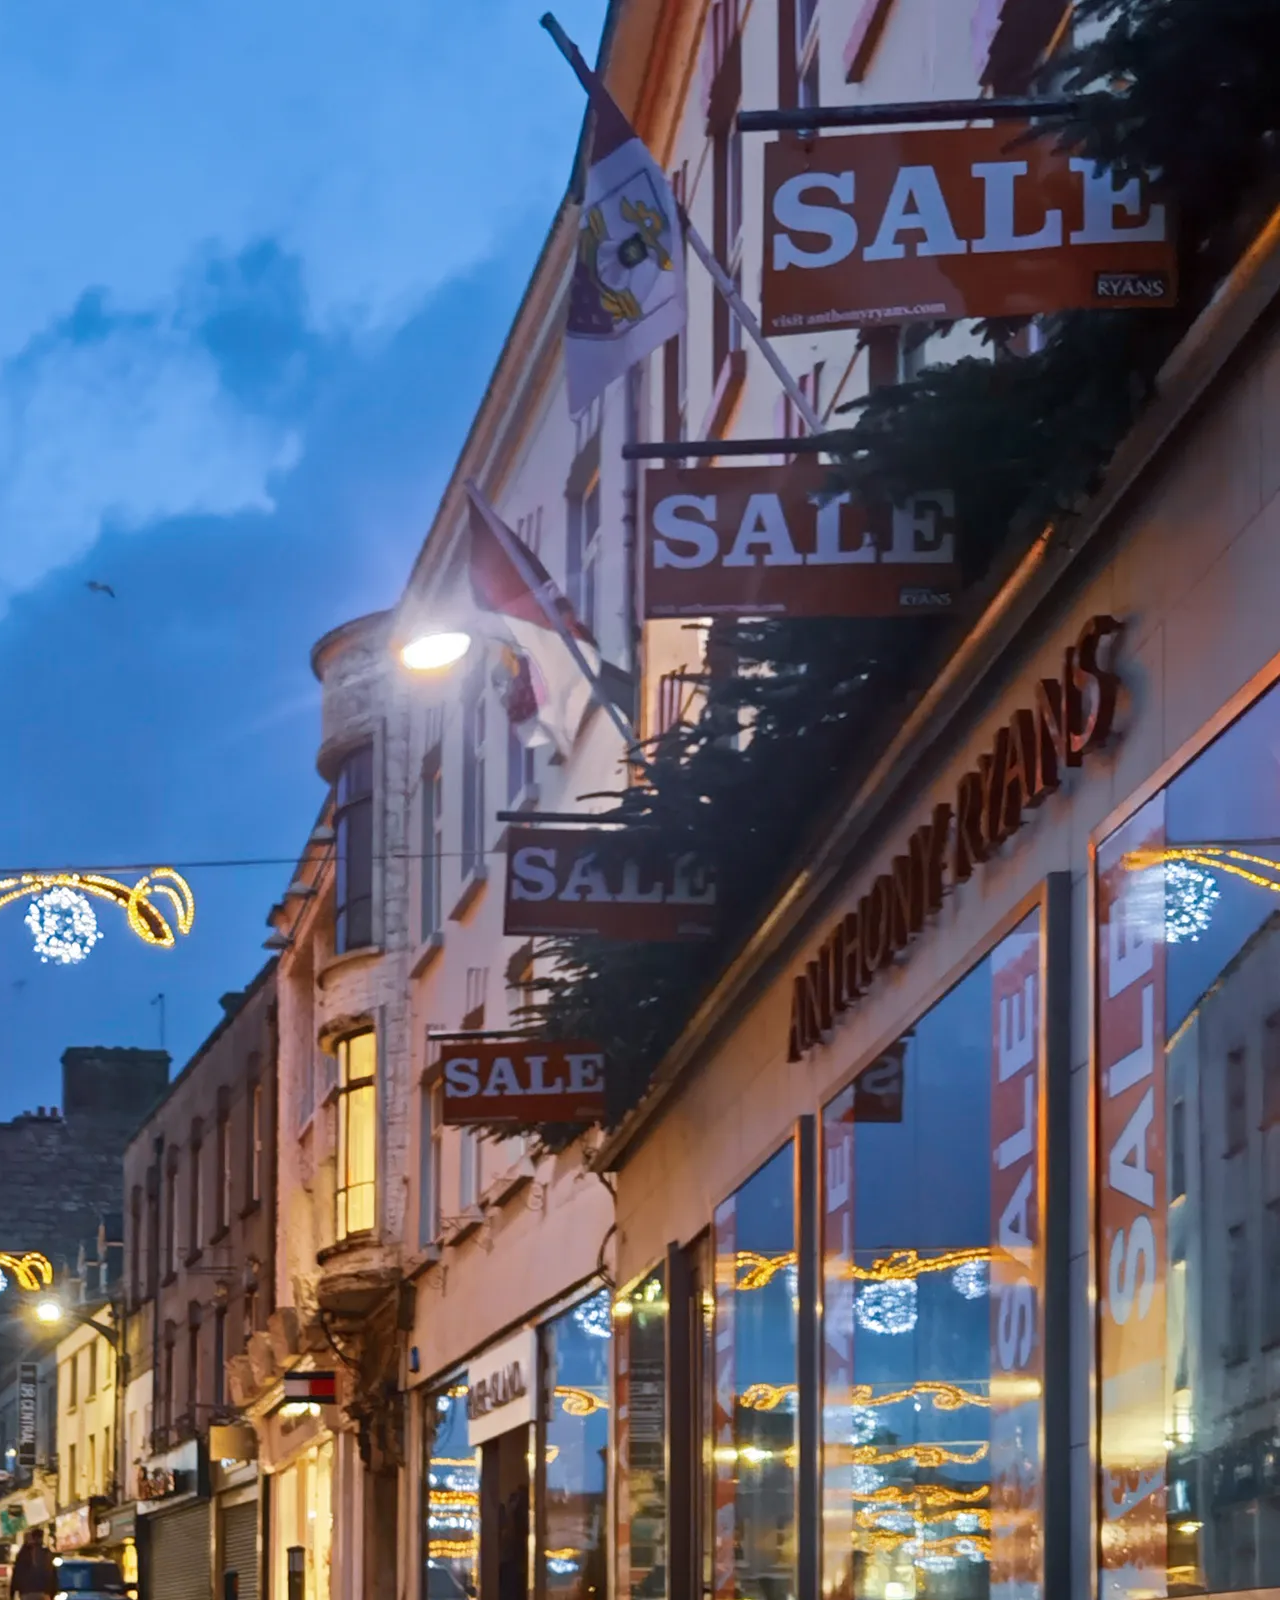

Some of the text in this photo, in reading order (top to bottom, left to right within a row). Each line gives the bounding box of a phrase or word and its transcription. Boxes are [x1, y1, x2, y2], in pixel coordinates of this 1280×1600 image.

[772, 157, 1166, 271] SALE
[1097, 279, 1164, 297] RYANS
[652, 490, 955, 569] SALE
[511, 846, 717, 905] SALE
[787, 614, 1126, 1064] ANTHONY RYANS
[444, 1053, 605, 1098] SALE
[1108, 868, 1157, 1327] SALE
[996, 972, 1035, 1372] SALE
